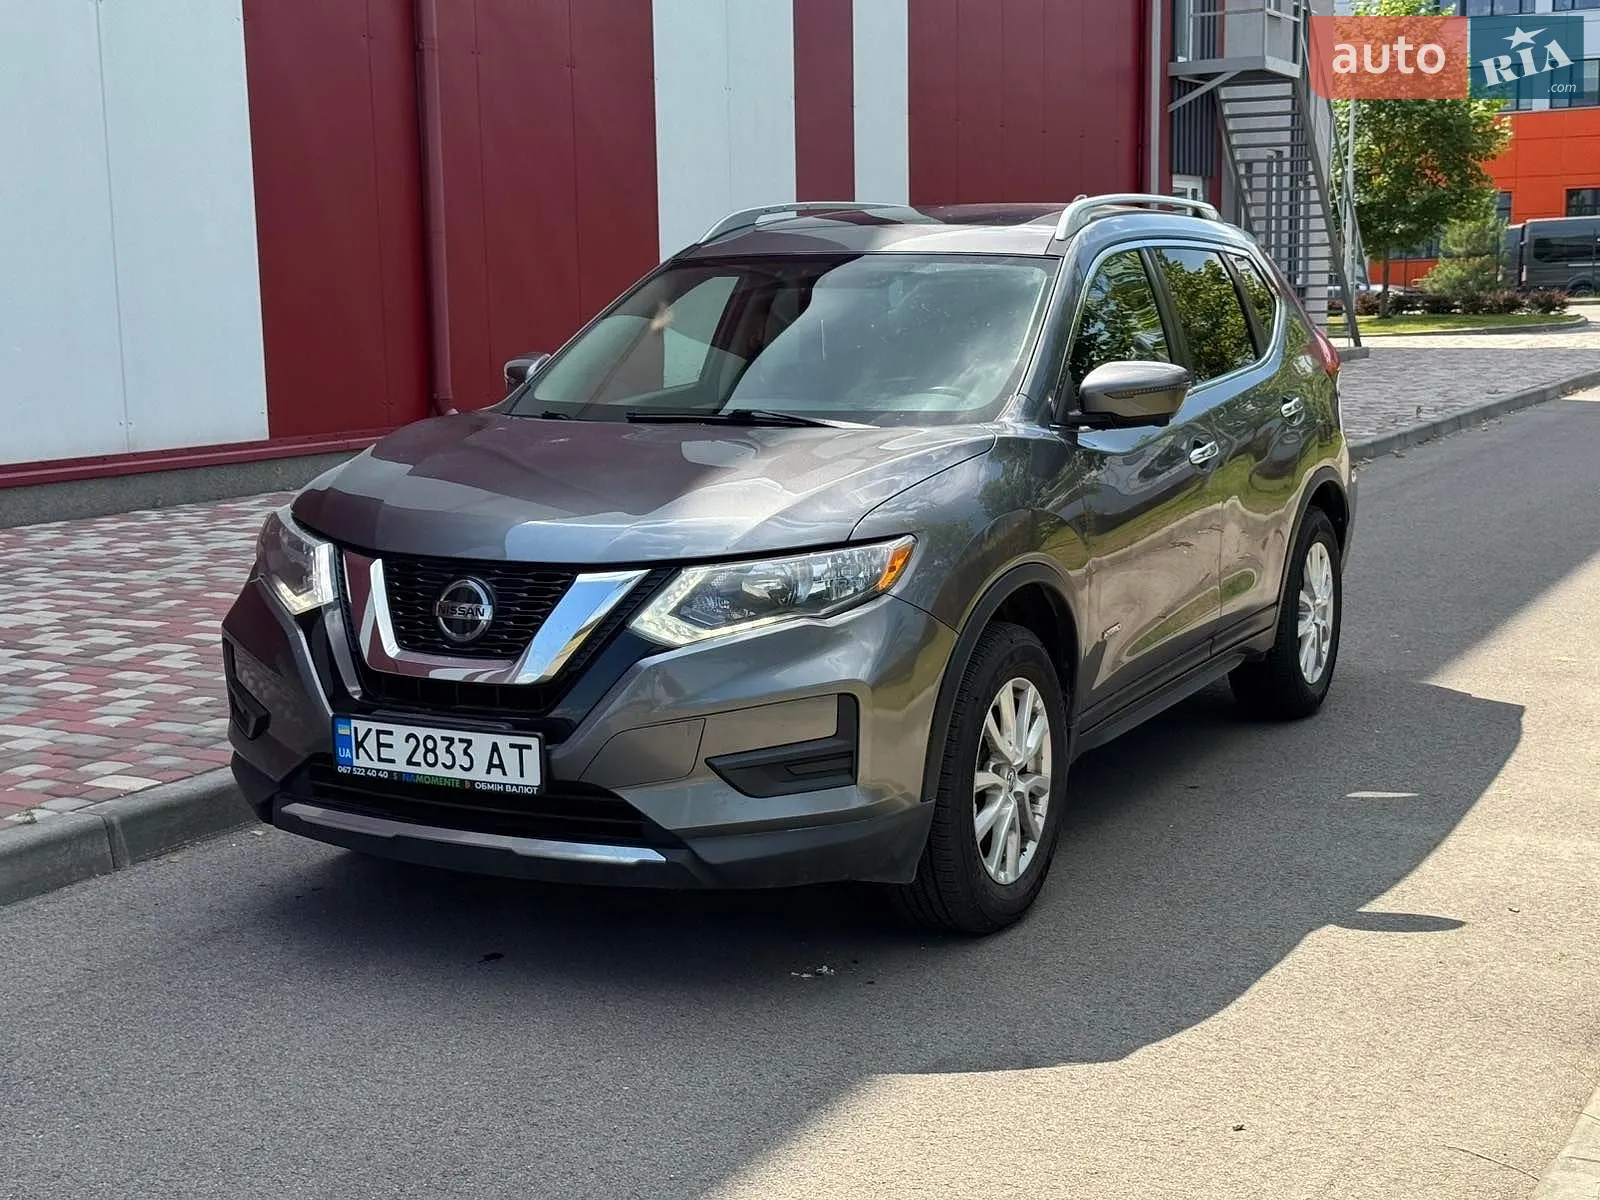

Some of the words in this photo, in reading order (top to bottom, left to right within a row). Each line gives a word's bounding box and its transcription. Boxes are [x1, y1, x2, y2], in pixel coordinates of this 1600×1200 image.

[438, 602, 485, 617] NISSAN
[339, 748, 352, 758] UA
[353, 726, 396, 764] KE
[404, 732, 475, 772] 2833
[485, 742, 533, 778] AT
[337, 765, 351, 774] 067
[353, 767, 366, 776] 522
[367, 768, 377, 777] 40
[378, 770, 389, 778] 40
[474, 781, 504, 791] ОБМІН
[505, 784, 539, 794] ВАЛЮТ
